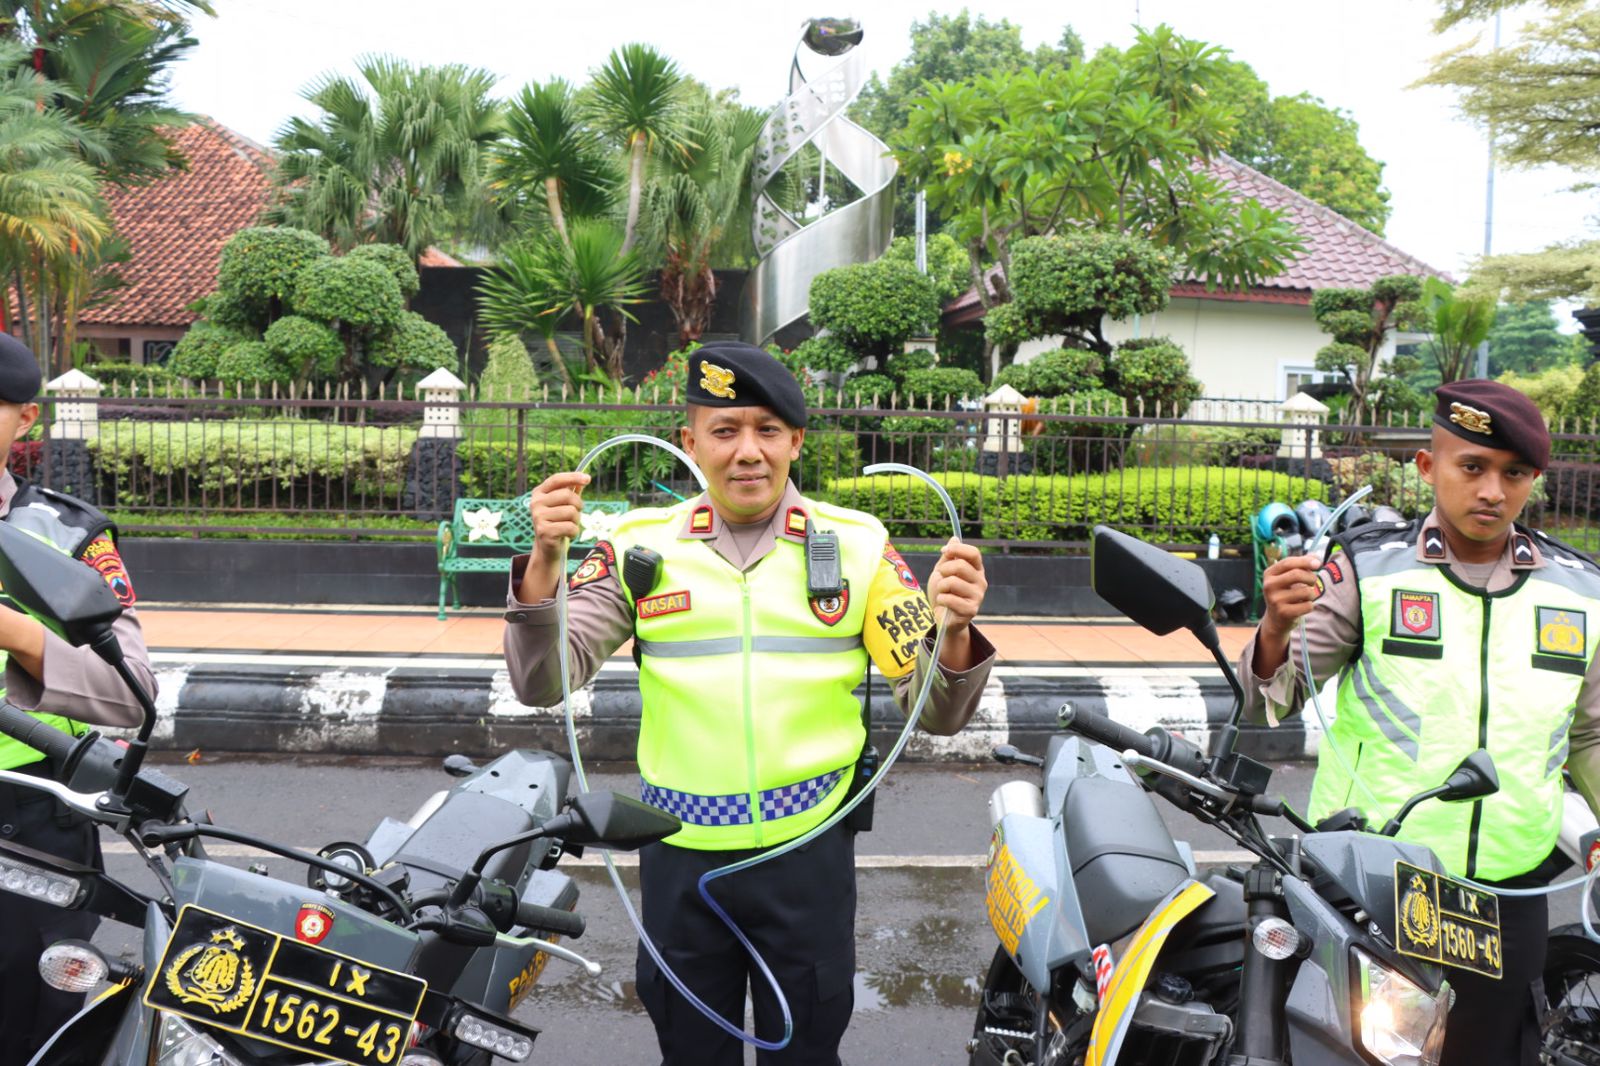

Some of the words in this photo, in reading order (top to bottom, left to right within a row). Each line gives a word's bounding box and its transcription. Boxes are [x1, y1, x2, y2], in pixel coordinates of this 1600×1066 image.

[641, 594, 686, 614] KASAT
[997, 844, 1050, 914] PATROLI
[1442, 921, 1500, 968] 1560-43
[261, 990, 402, 1063] 1562-43
